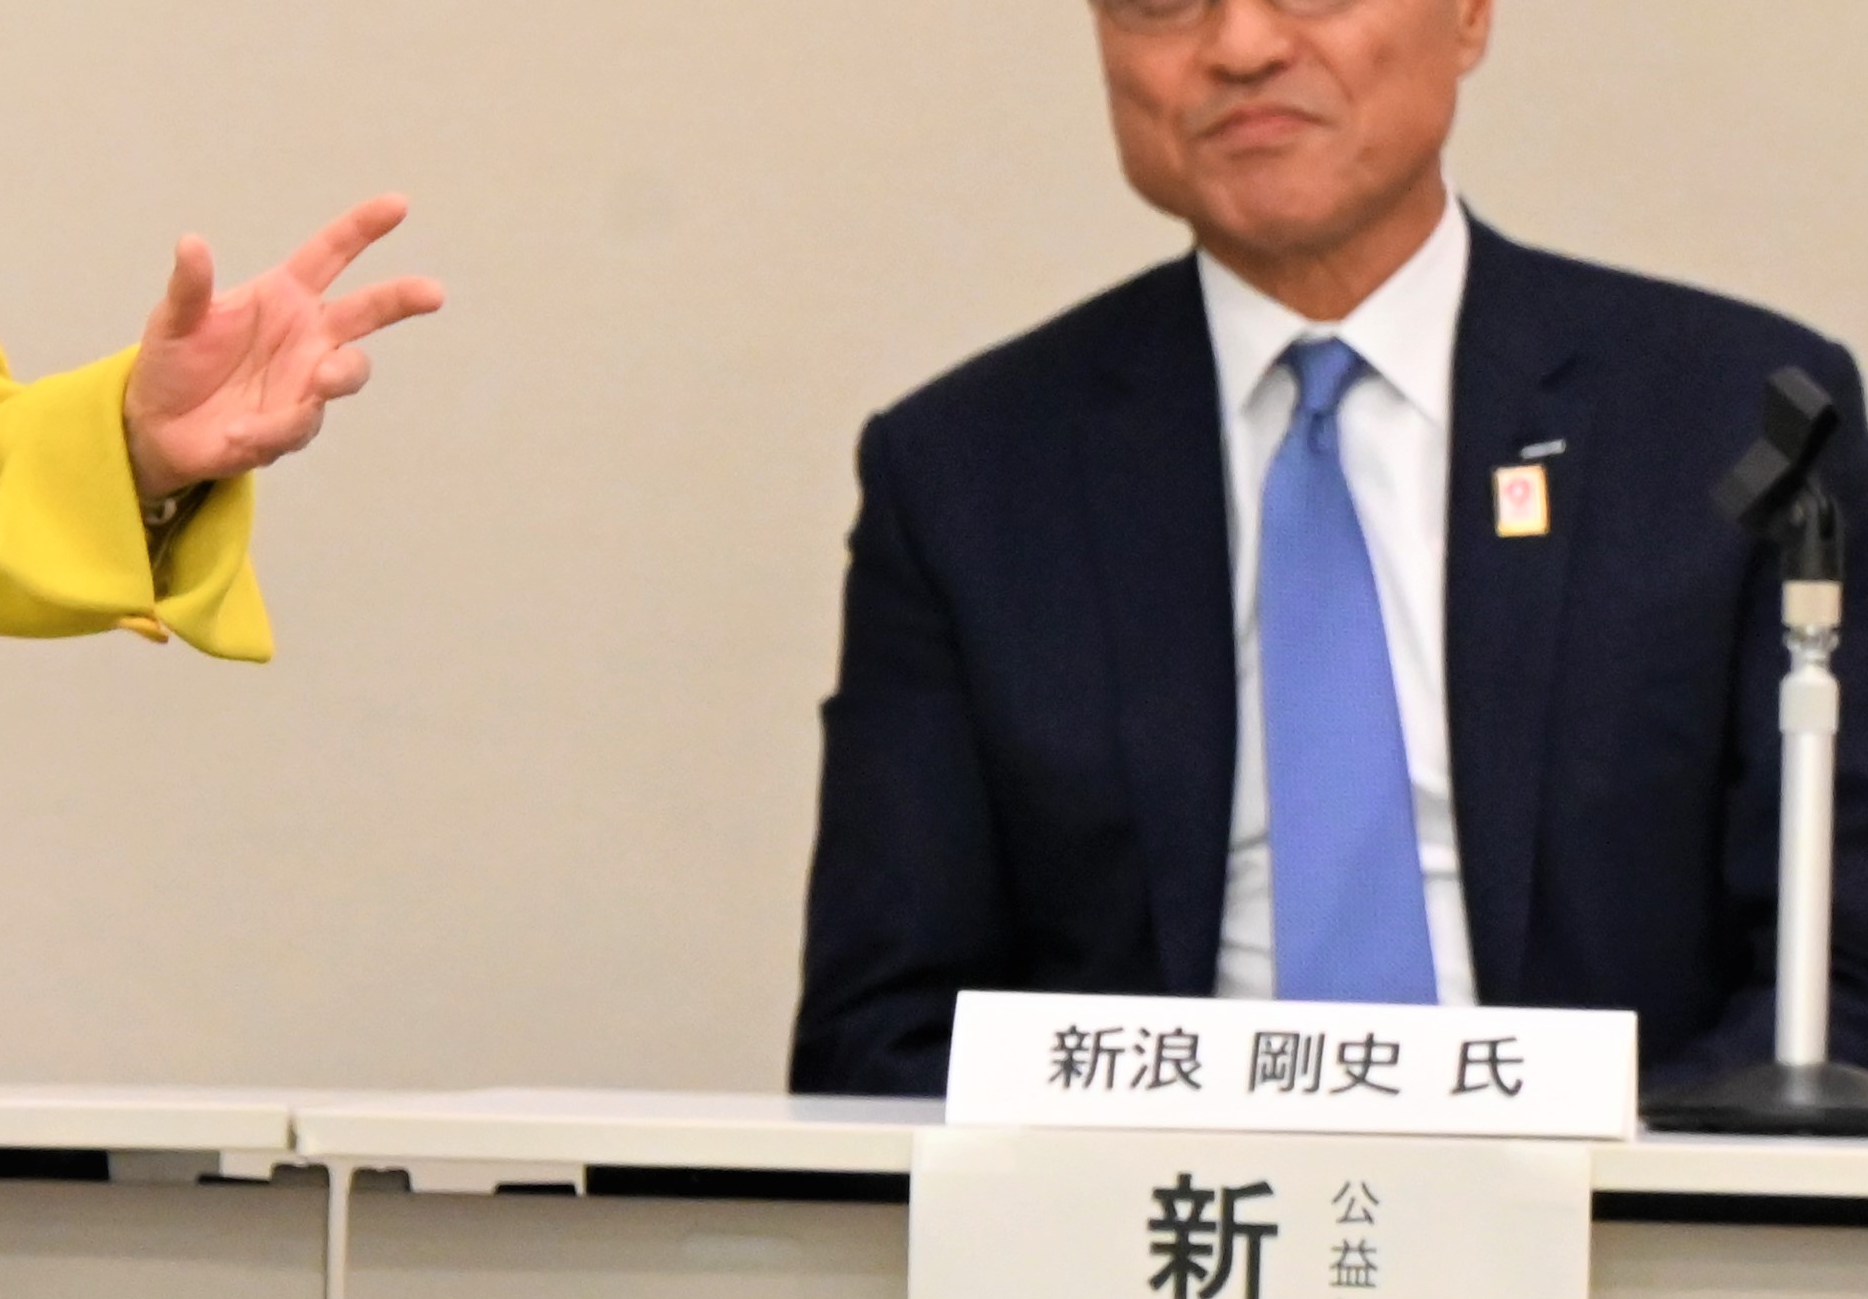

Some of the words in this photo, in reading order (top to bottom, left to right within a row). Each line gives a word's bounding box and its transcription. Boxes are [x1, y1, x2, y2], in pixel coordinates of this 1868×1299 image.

[1048, 1024, 1202, 1091] 新浪
[1247, 1031, 1401, 1097] 剛史
[1450, 1036, 1524, 1097] 氏
